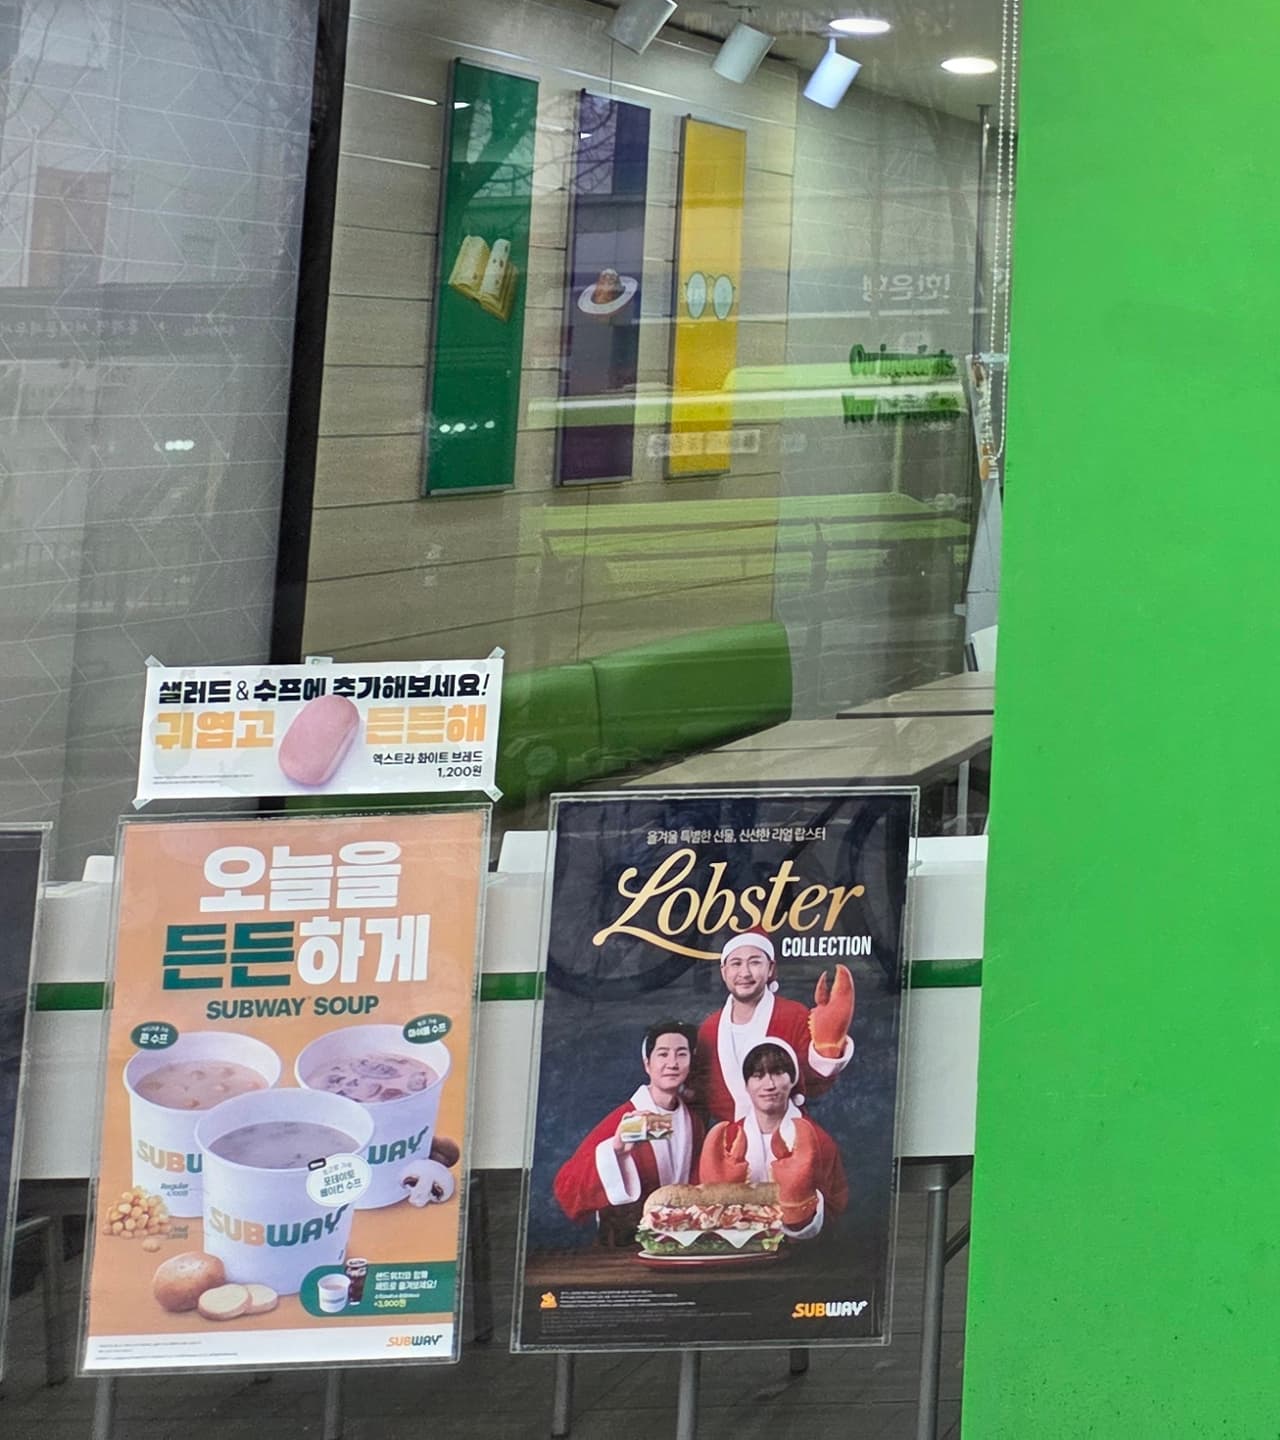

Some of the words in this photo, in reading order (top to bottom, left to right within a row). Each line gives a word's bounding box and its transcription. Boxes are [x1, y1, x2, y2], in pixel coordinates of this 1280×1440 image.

[159, 679, 232, 706] 샐러드
[236, 682, 249, 702] &
[253, 677, 326, 702] 수프에
[155, 710, 276, 750] 귀엽고
[365, 704, 487, 745] 든든해
[373, 753, 415, 766] 엑스트라
[418, 752, 449, 765] 화이트
[451, 751, 483, 764] 브레드
[437, 765, 483, 779] 1,200원
[647, 830, 678, 845] 올겨울
[680, 829, 711, 844] 특별한
[739, 828, 770, 843] 신선한
[772, 828, 793, 842] 리얼
[794, 827, 826, 841] 랍스터
[200, 840, 401, 913] 오늘을
[592, 848, 865, 960] Lobster
[162, 914, 430, 991] 든든하게
[781, 936, 871, 957] COLLECTION
[206, 997, 305, 1021] SUBWAY
[313, 995, 379, 1017] SOUP
[209, 1204, 349, 1247] SUBWAY
[792, 1300, 869, 1319] SUBWAY
[386, 1335, 443, 1347] SUBWAY
